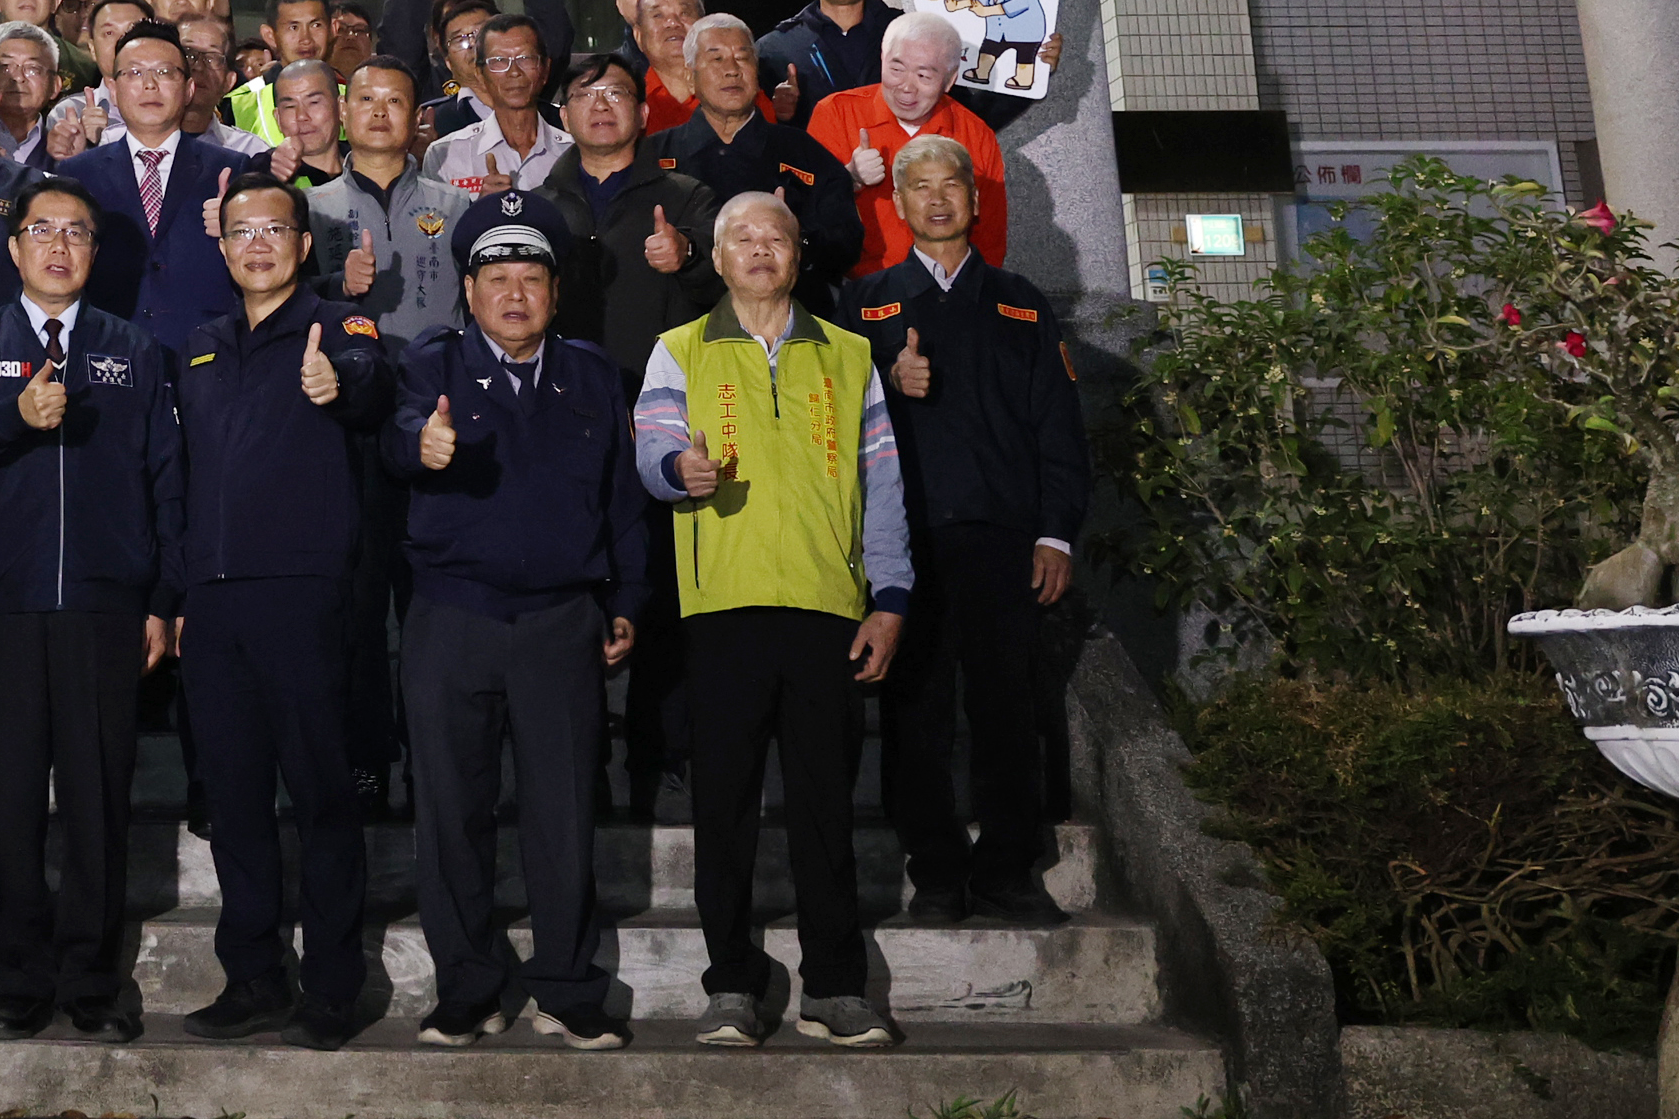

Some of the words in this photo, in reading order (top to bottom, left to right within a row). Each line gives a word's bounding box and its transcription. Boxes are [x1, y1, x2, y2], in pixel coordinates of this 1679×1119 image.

[718, 383, 739, 480] 志工中隊長
